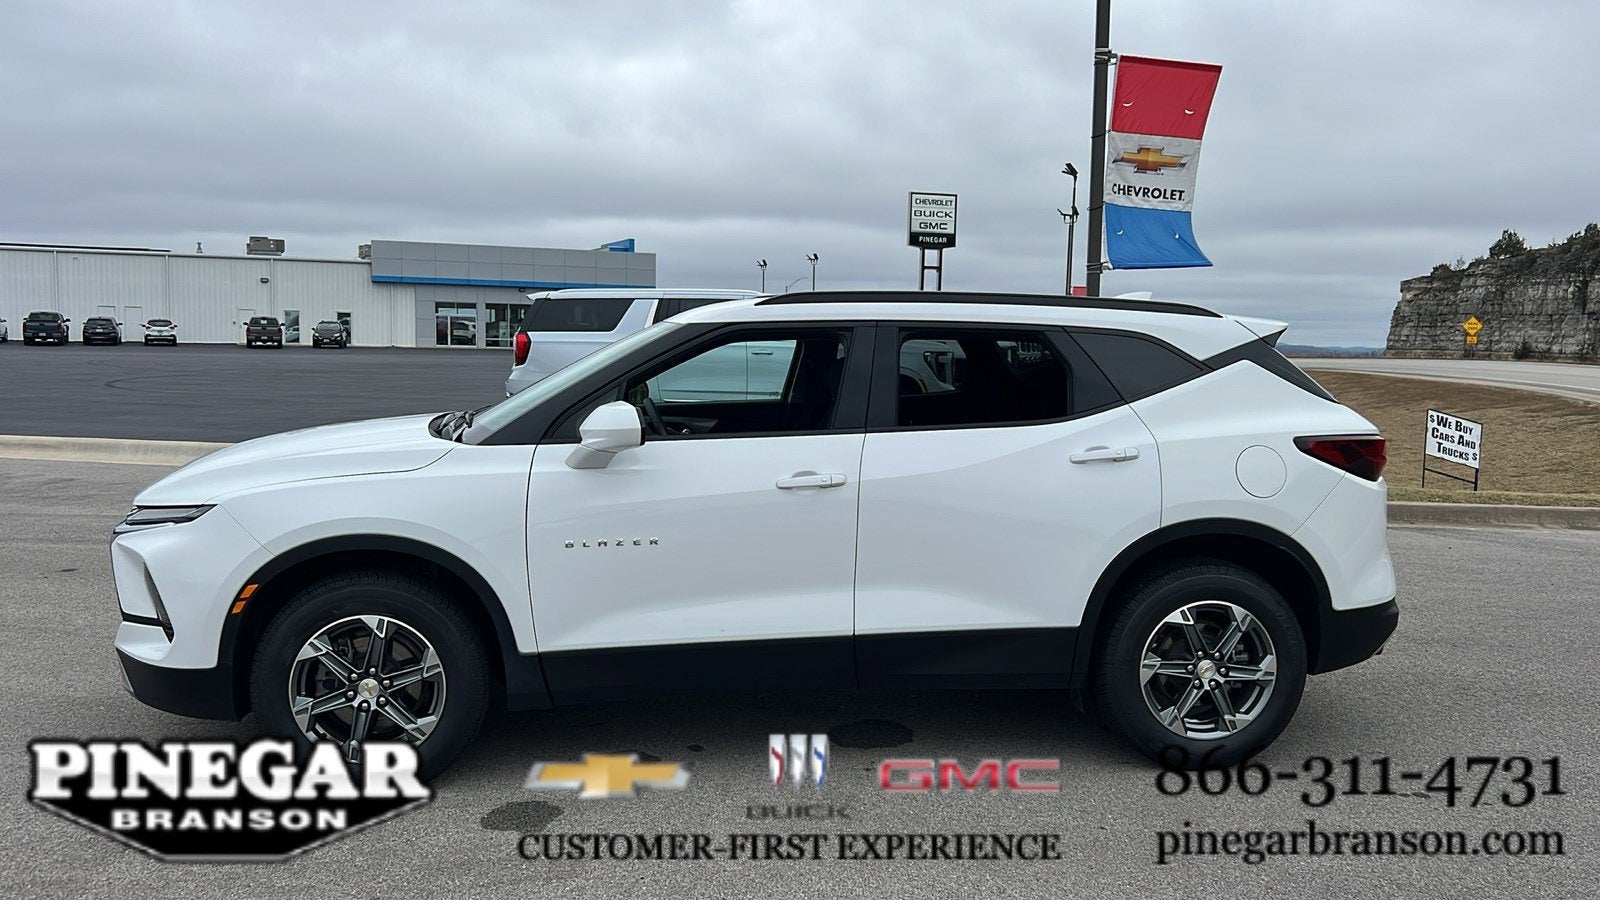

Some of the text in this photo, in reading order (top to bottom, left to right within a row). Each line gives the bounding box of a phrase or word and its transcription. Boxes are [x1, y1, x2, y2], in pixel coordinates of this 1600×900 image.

[1112, 183, 1185, 201] CHEVROLET
[915, 198, 954, 207] CHEVROLET
[914, 210, 953, 219] BUICK
[919, 222, 948, 231] GMC
[919, 236, 948, 244] PINEGAR
[564, 537, 659, 549] BLAZER
